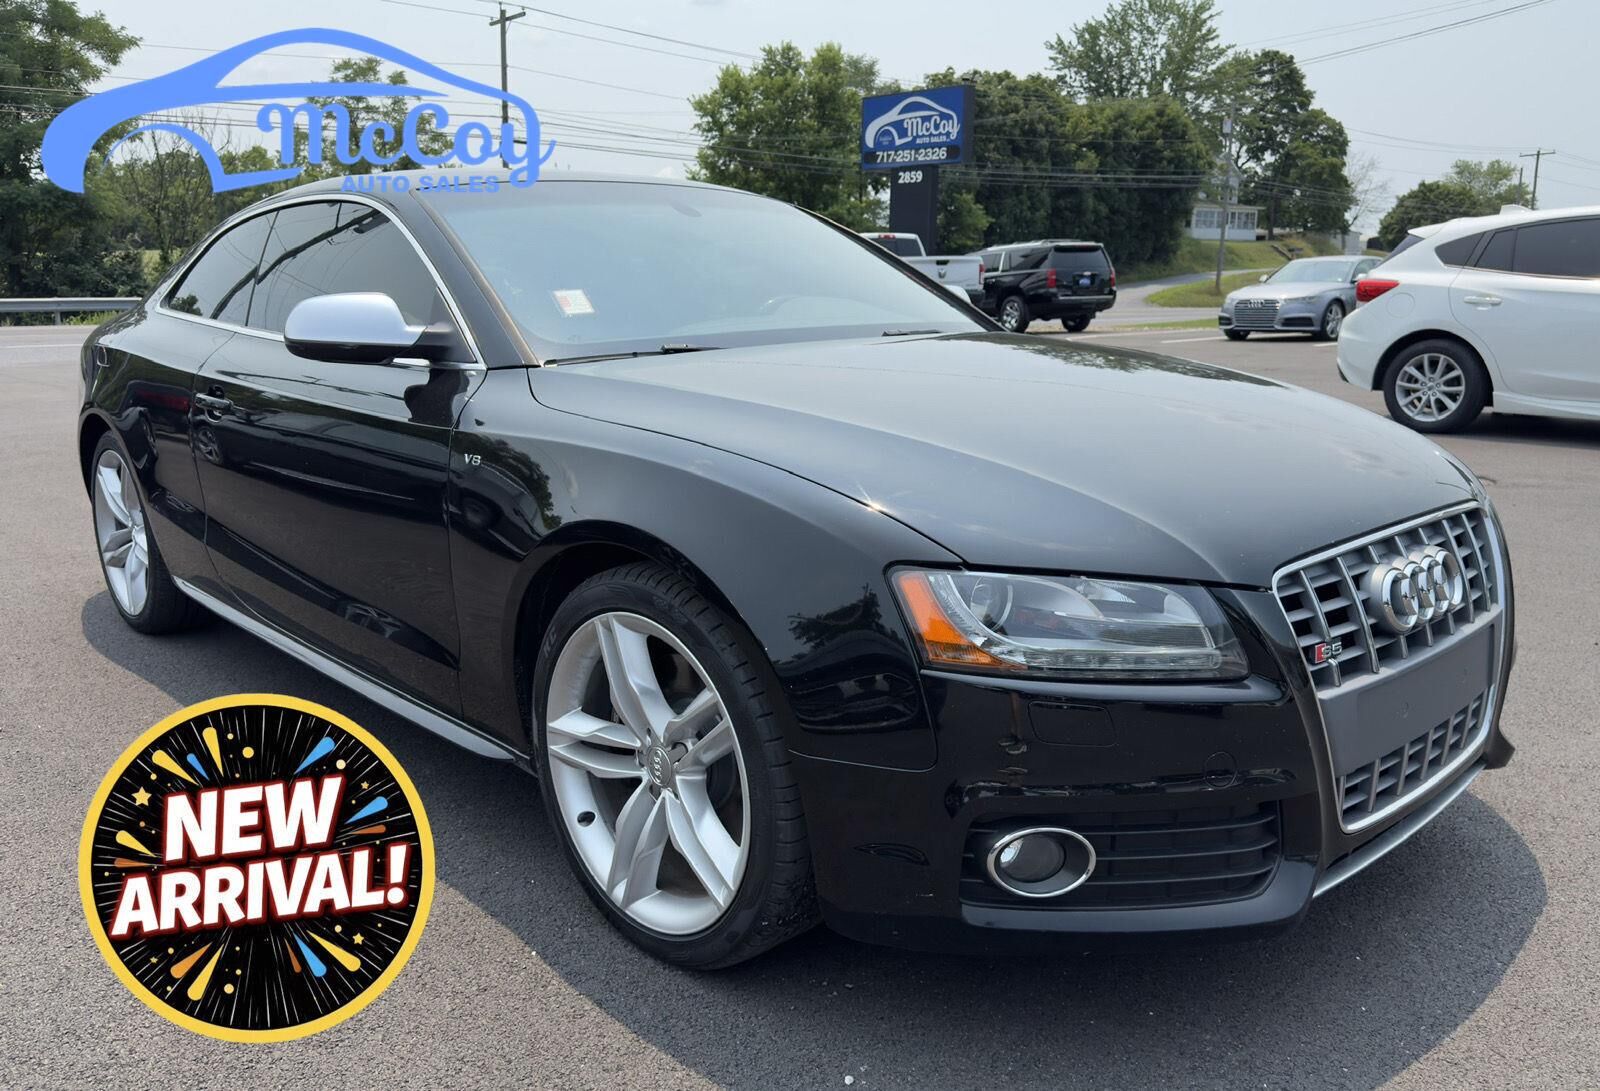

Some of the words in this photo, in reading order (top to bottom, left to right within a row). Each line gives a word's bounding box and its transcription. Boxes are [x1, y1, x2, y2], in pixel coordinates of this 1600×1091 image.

[904, 116, 960, 140] McCoy
[876, 148, 947, 163] 717-251-2326
[898, 171, 923, 183] 2859
[464, 453, 481, 466] V8
